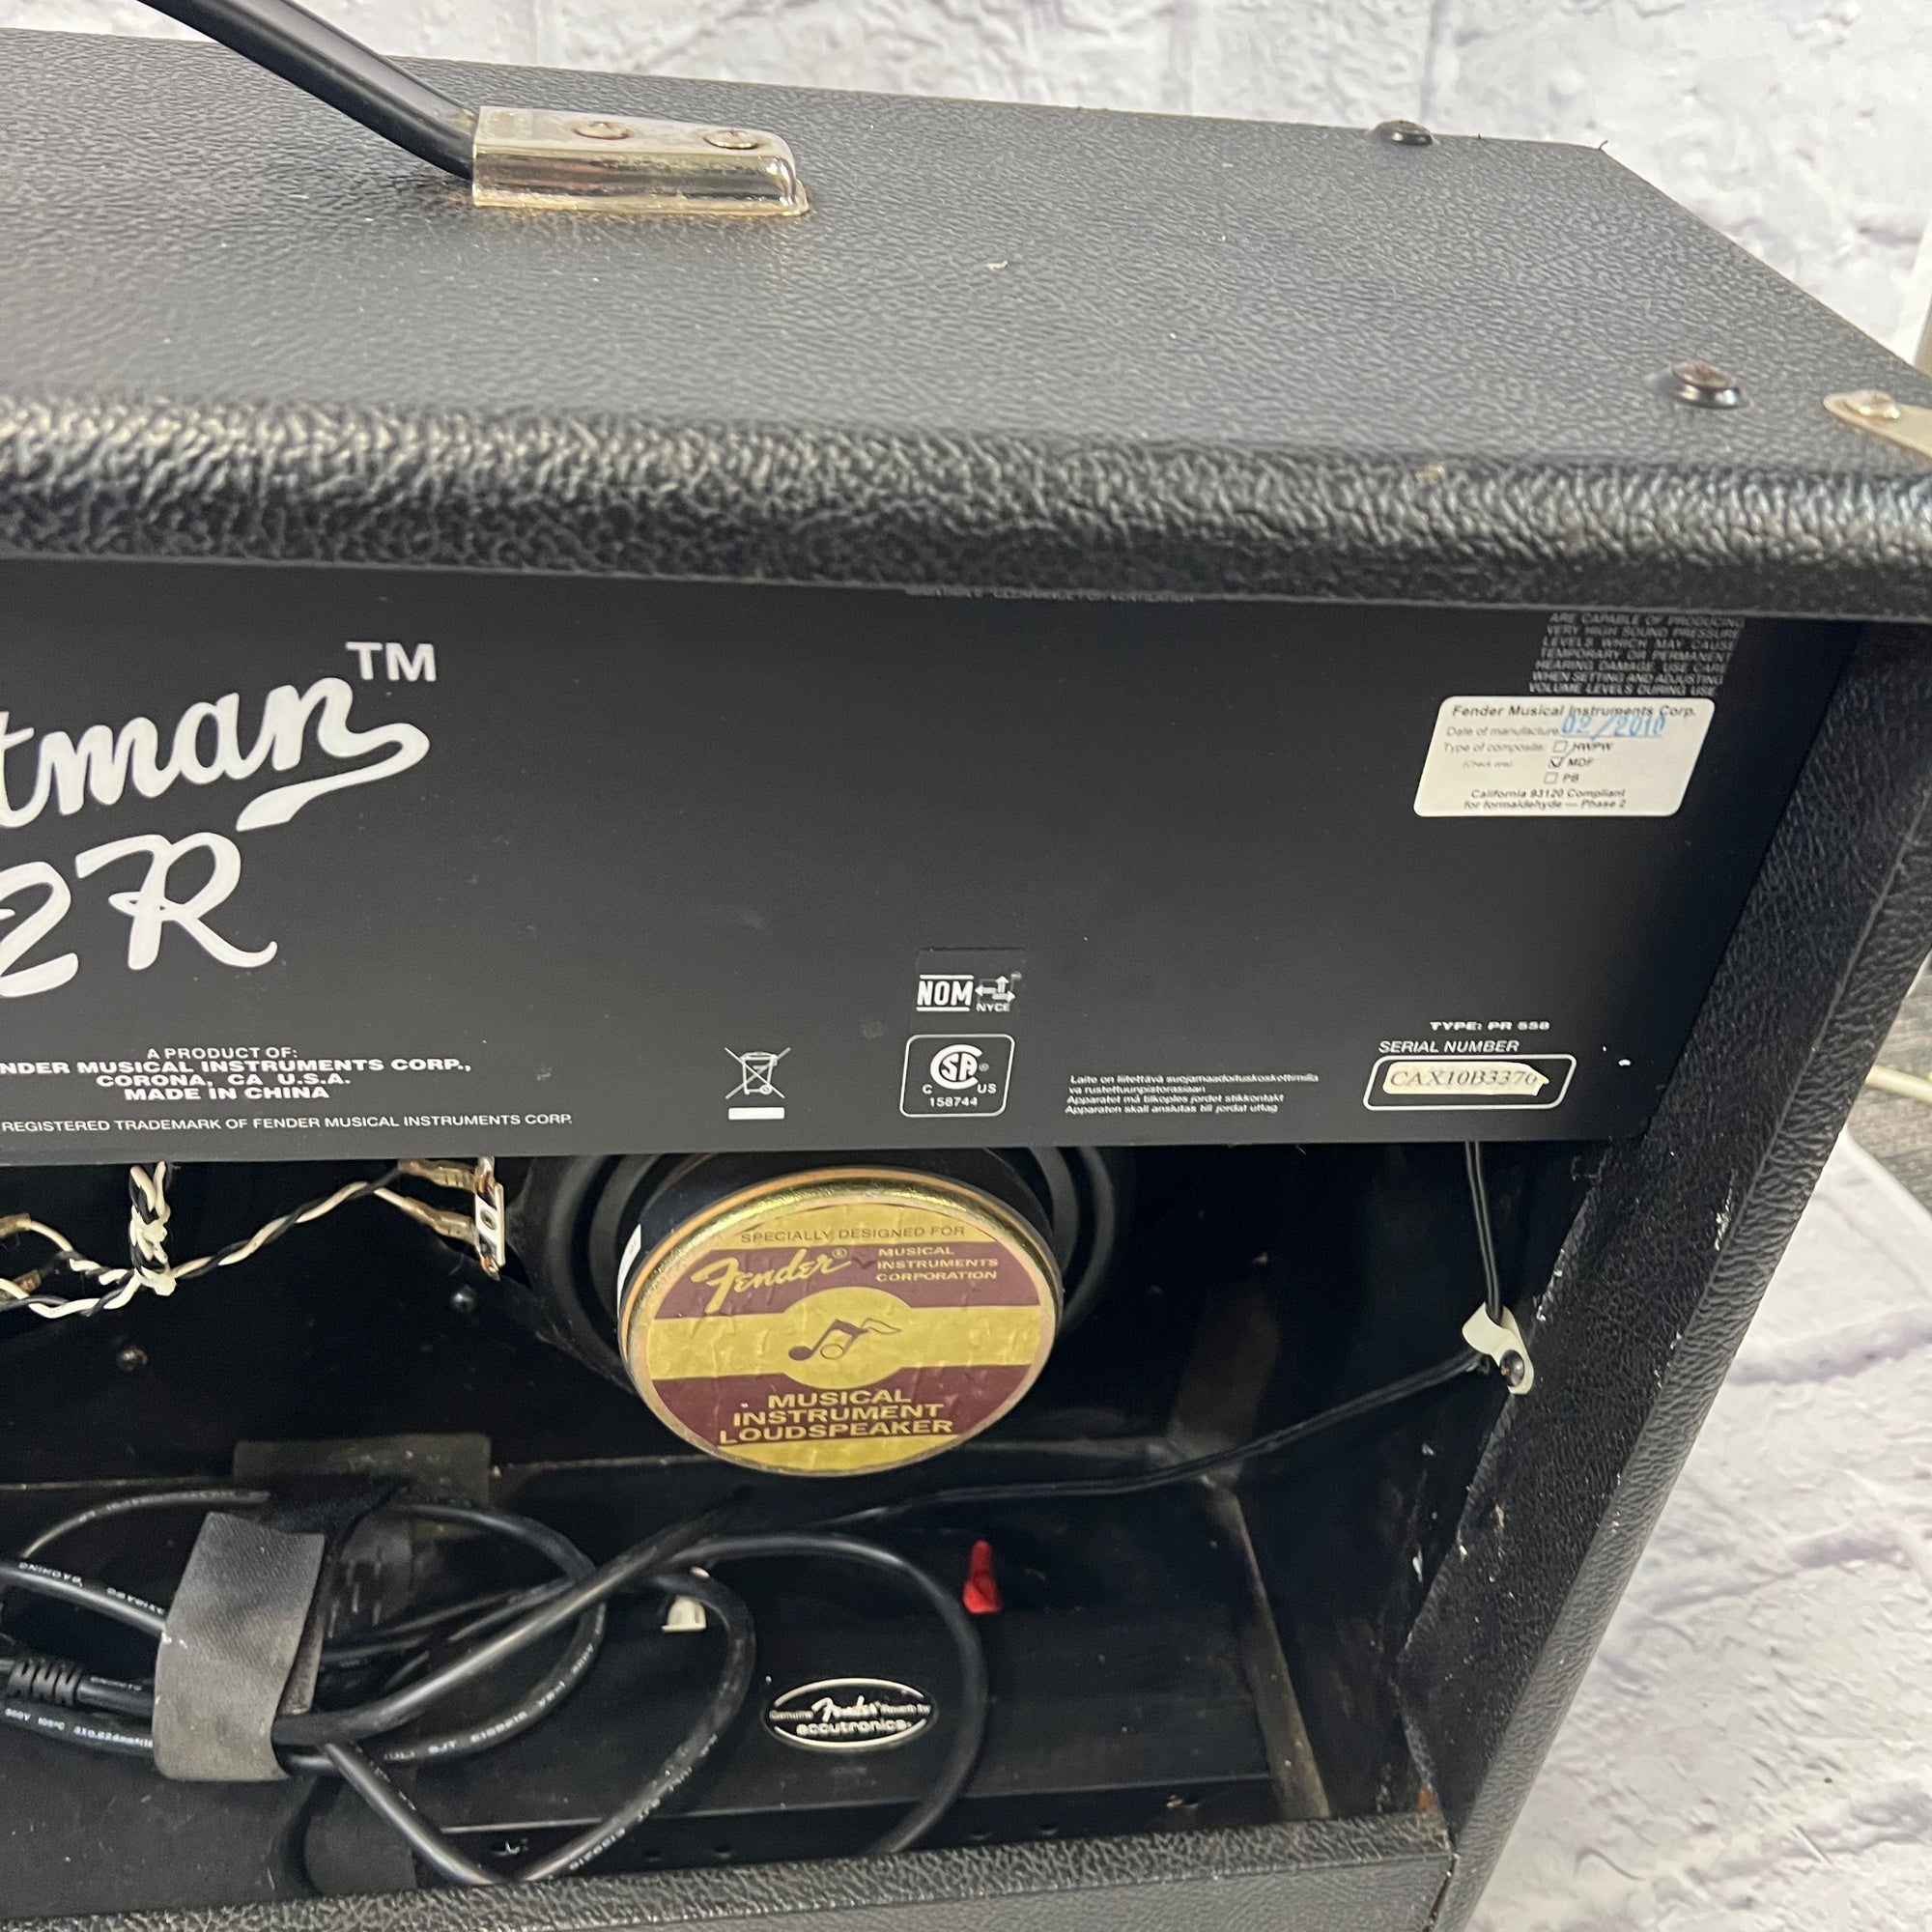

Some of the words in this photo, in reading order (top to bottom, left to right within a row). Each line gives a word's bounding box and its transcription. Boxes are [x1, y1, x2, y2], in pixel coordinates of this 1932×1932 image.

[345, 641, 438, 682] TM
[1452, 704, 1503, 717] Fender
[1508, 704, 1564, 717] Musical
[1568, 704, 1653, 717] Instruments
[1659, 705, 1696, 718] Corp.
[1446, 726, 1473, 736] Date
[1476, 726, 1489, 736] of
[1567, 758, 1596, 768] MDF
[1562, 773, 1580, 783] PB
[1470, 789, 1526, 799] California
[1567, 788, 1627, 800] Compliant
[917, 980, 975, 1007] NOM
[976, 1003, 1011, 1012] NYCE
[1430, 1021, 1483, 1031] TYPE:
[1488, 1021, 1513, 1031] PR
[147, 1047, 160, 1060] A
[164, 1047, 260, 1060] PRODUCT
[265, 1046, 298, 1059] OF:
[1378, 1040, 1439, 1053] SERIAL
[1444, 1039, 1520, 1053] NUMBER
[0, 1061, 71, 1074] NDER
[77, 1061, 194, 1074] MUSICAL
[201, 1059, 384, 1072] INSTRUMENTS
[390, 1058, 471, 1072] CORP.,
[97, 1074, 214, 1088] CORONA,
[228, 1073, 264, 1086] CA
[277, 1073, 352, 1086] U.S.A.
[125, 1088, 202, 1100] MADE
[209, 1087, 238, 1100] IN
[243, 1086, 329, 1099] CHINA
[977, 1083, 997, 1094] US
[929, 1096, 979, 1107] 158744
[2, 1121, 110, 1132] REGISTERED
[114, 1119, 221, 1130] TRADEMARK
[225, 1118, 247, 1129] OF
[253, 1117, 321, 1128] FENDER
[325, 1116, 400, 1128] MUSICAL
[404, 1115, 521, 1126] INSTRUMENTS
[525, 1114, 573, 1125] CORP.
[741, 1230, 830, 1243] SPECIALLY
[838, 1227, 925, 1240] DESIGNED
[930, 1226, 965, 1237] FOR
[878, 1245, 954, 1257] MUSICAL
[876, 1258, 999, 1269] INSTRUMENTS
[875, 1270, 997, 1283] CORPORATION
[768, 1388, 912, 1409] MUSICAL
[733, 1404, 944, 1427] INSTRUMENT
[720, 1419, 952, 1445] LOUDSPEAKER
